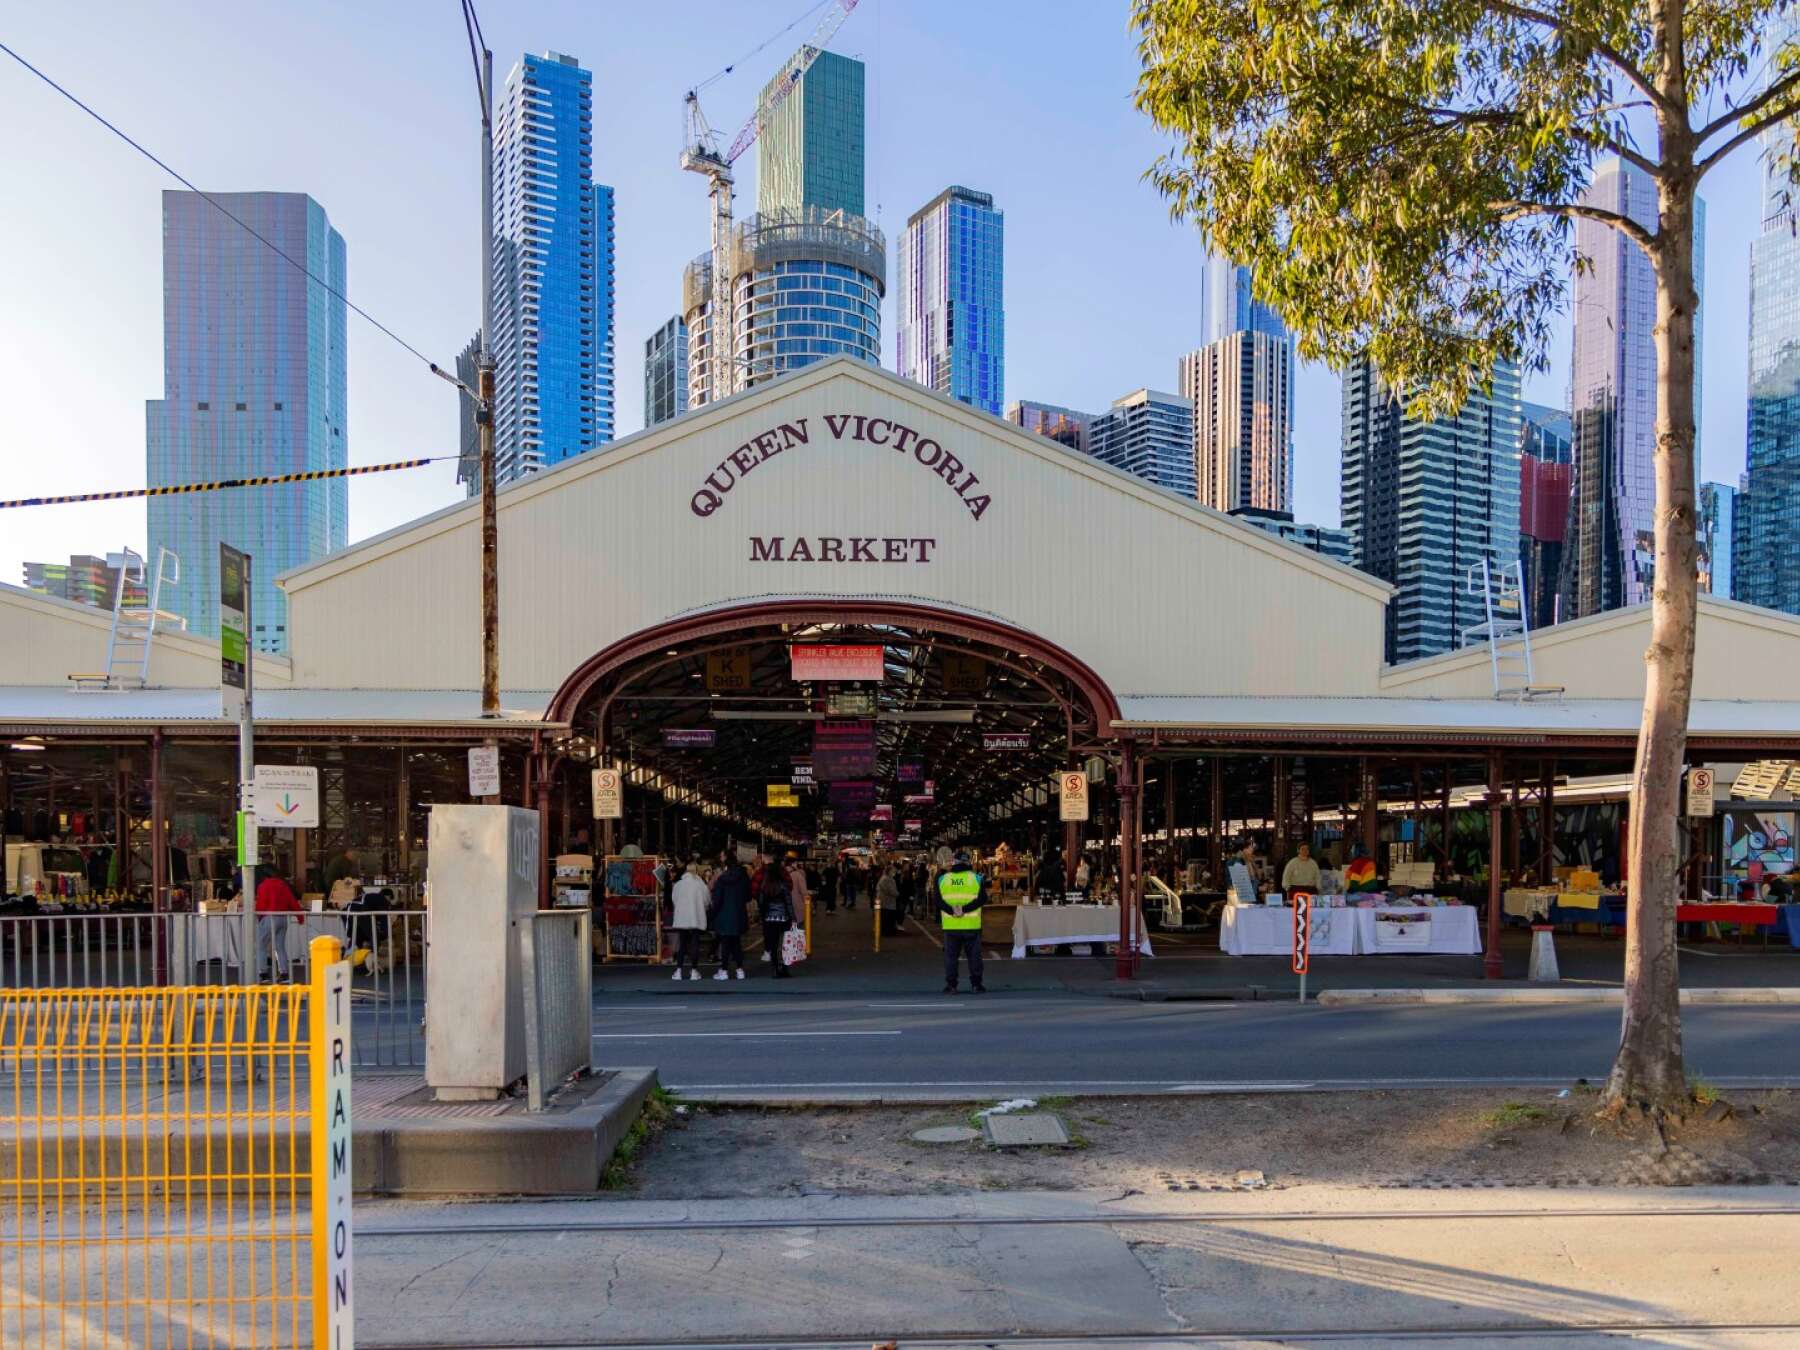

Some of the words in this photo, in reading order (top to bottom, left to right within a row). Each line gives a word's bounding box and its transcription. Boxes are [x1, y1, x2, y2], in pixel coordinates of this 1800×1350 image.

[691, 418, 809, 517] QUEEN
[823, 414, 992, 521] VICTORIA
[749, 536, 936, 563] MARKET
[722, 659, 734, 673] K
[713, 675, 744, 687] SHED
[791, 775, 817, 785] VIND
[332, 986, 346, 1180] TRAM
